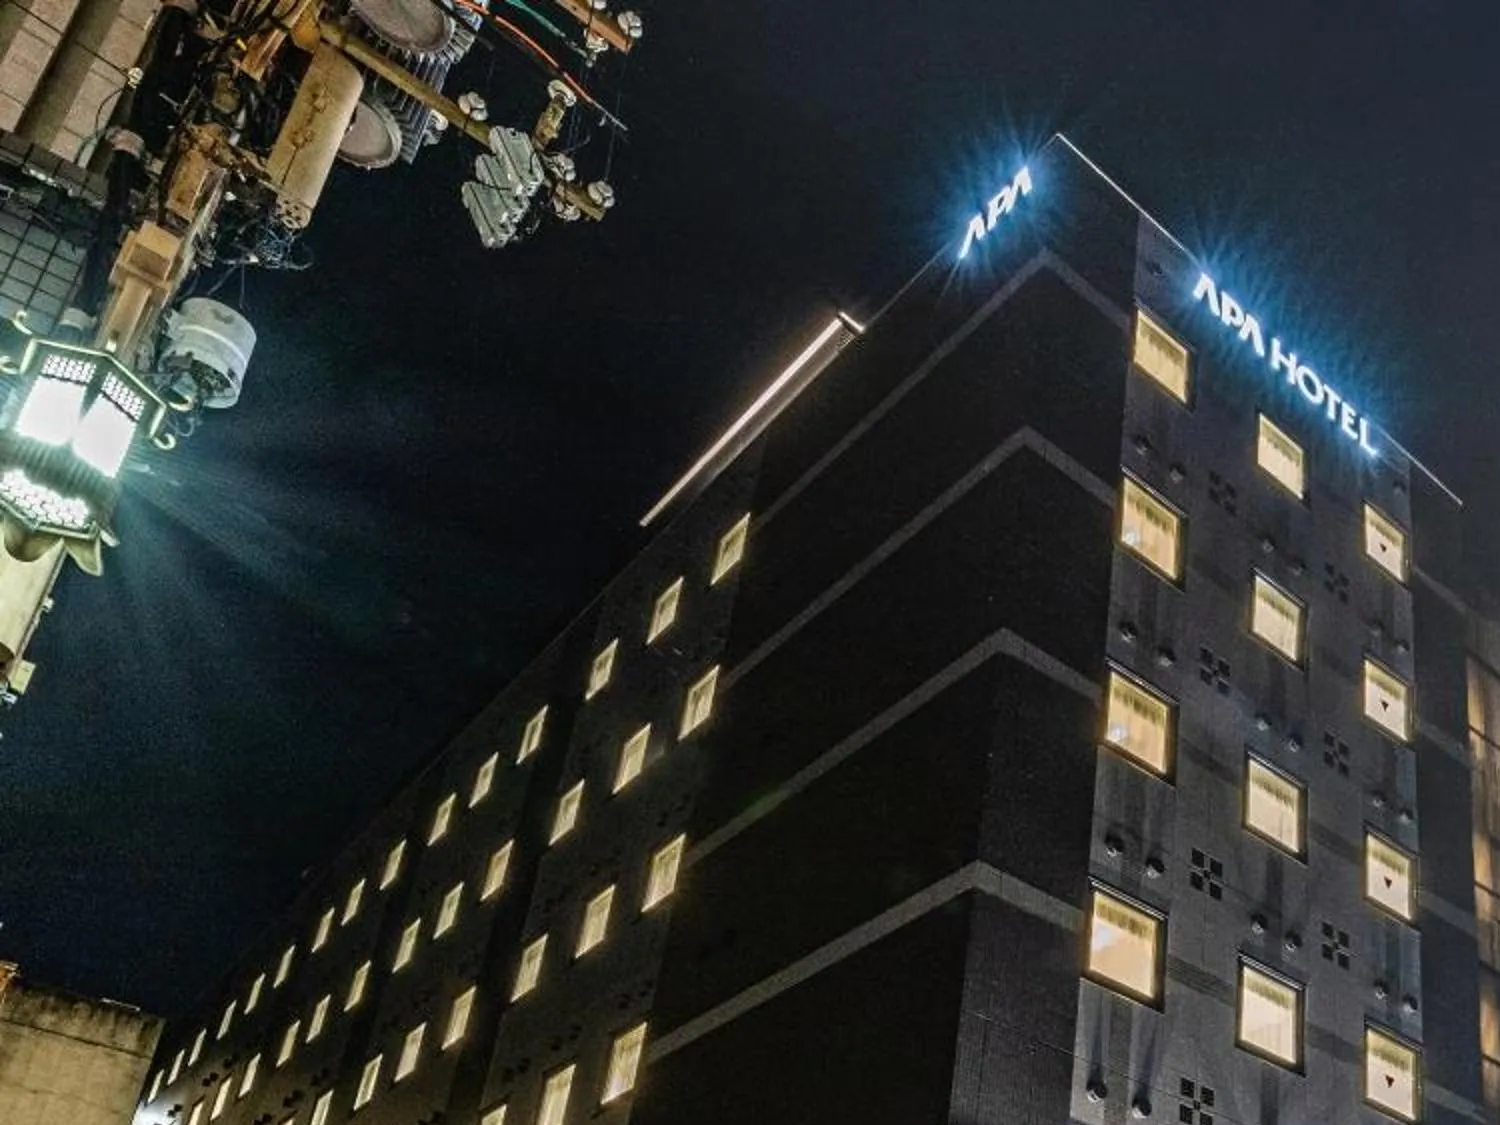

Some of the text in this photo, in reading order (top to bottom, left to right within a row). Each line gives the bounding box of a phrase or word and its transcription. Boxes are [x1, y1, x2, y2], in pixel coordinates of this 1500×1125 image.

[958, 166, 1033, 259] APA
[1192, 272, 1379, 457] APA HOTEL
